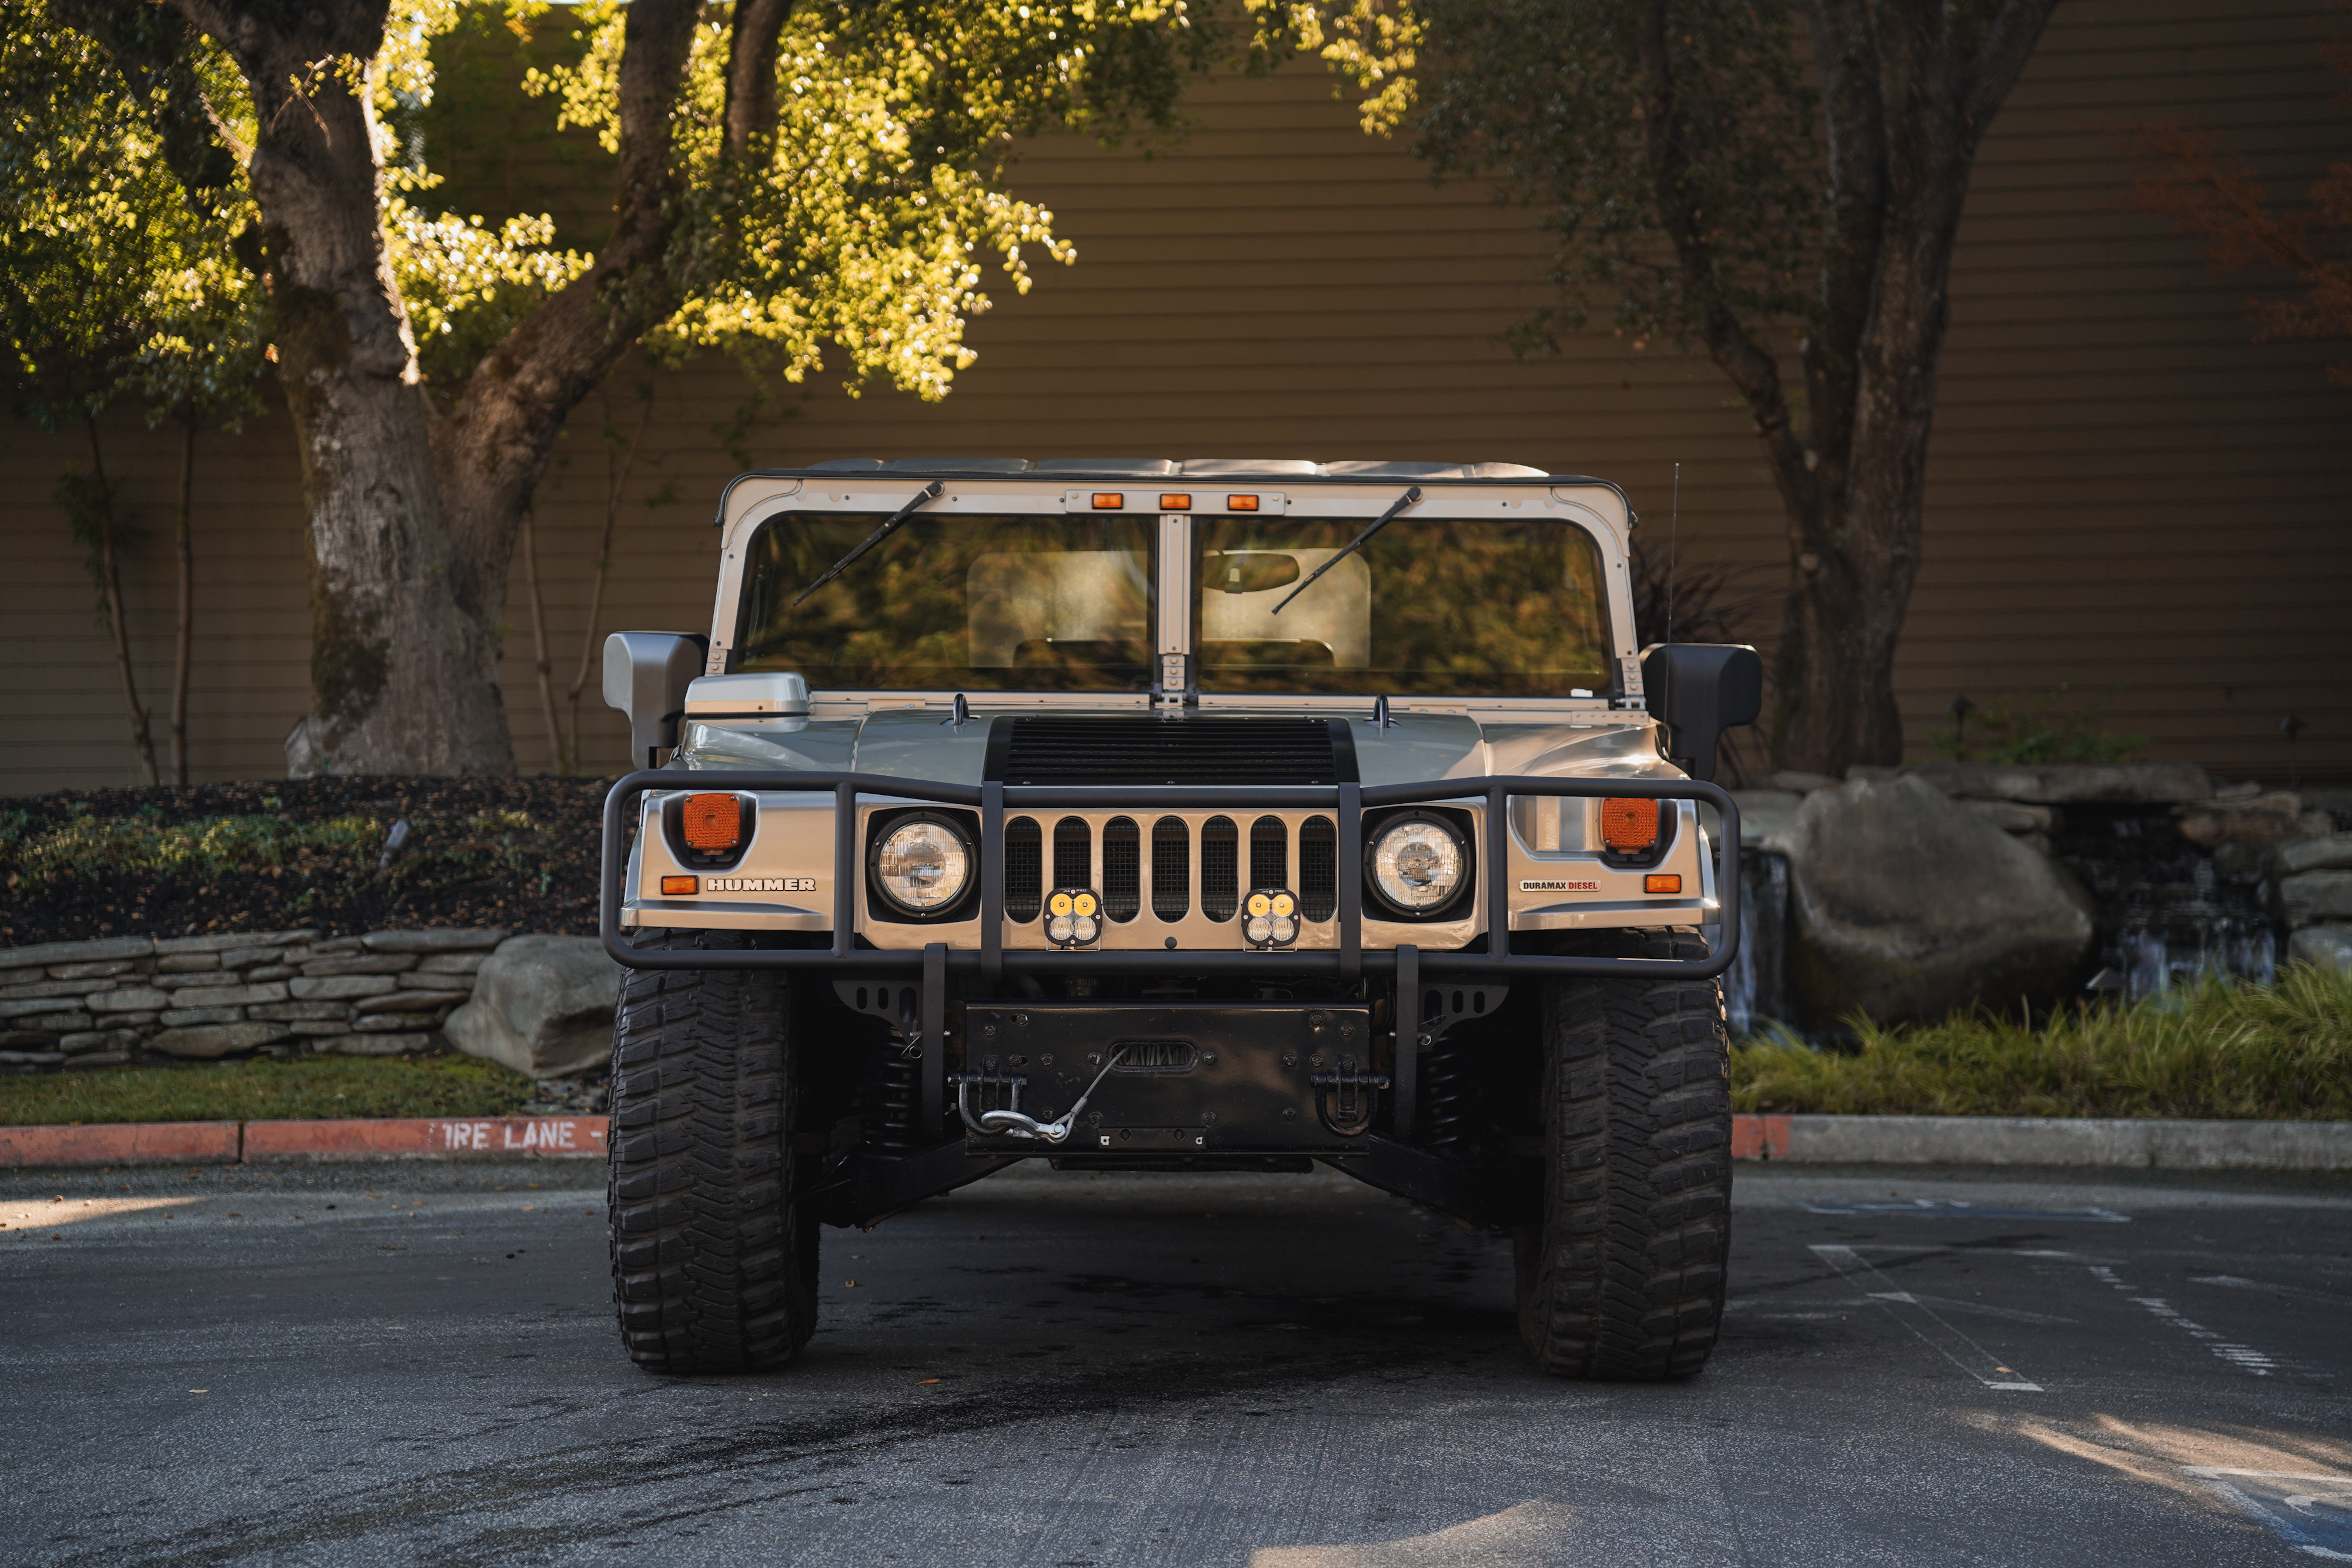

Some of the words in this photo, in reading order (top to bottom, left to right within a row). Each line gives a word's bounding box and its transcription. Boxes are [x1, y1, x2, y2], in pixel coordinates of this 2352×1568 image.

[707, 878, 816, 891] HUMMER
[429, 1122, 492, 1149] IRE
[504, 1121, 576, 1149] LANE
